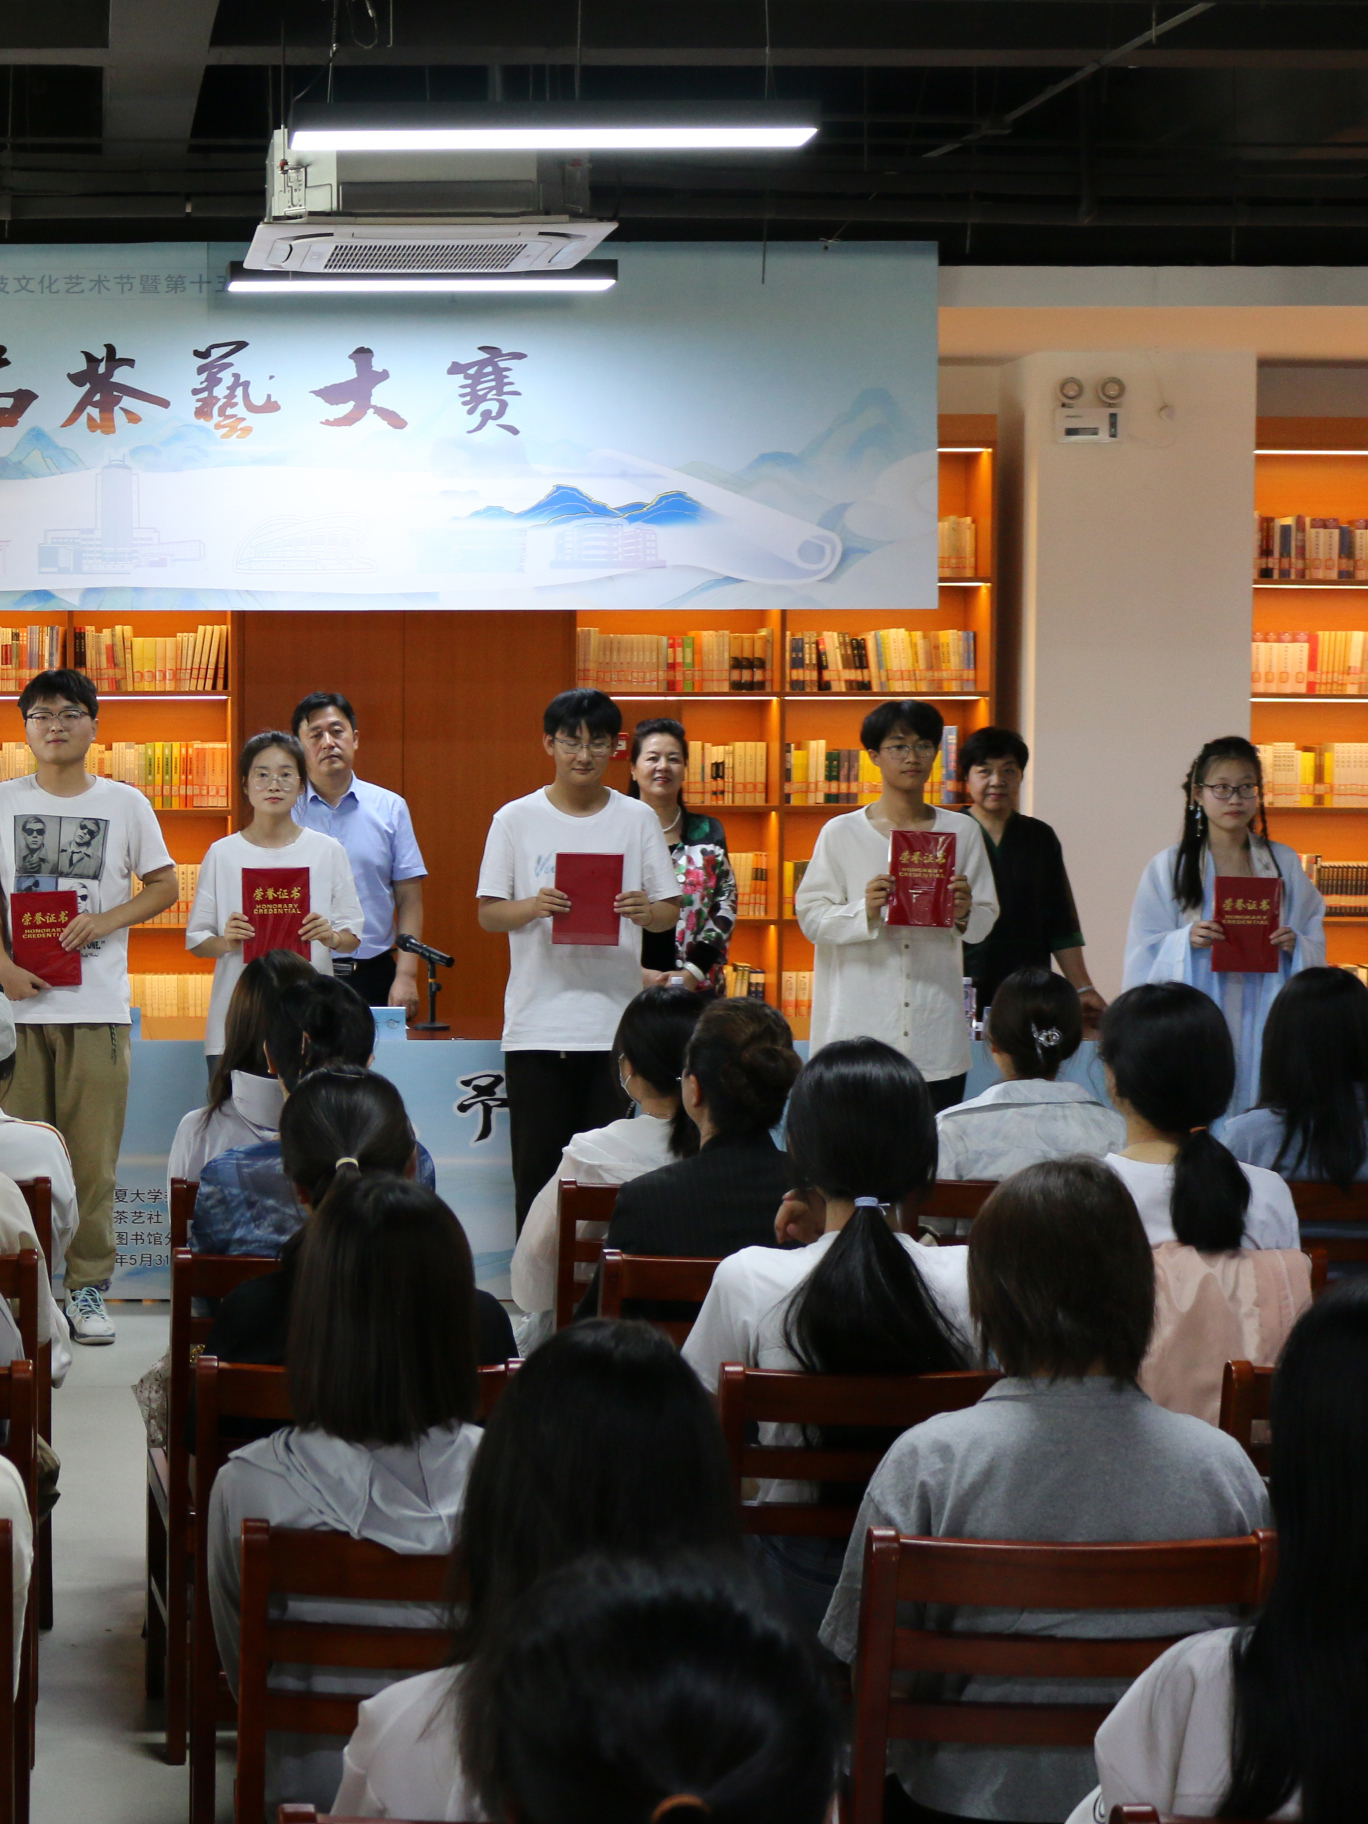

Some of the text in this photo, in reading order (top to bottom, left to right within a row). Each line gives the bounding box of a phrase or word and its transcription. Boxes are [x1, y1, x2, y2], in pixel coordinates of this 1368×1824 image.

[253, 887, 301, 901] 荣誉证书
[1222, 898, 1270, 911] 荣誉证书
[22, 911, 69, 926] 荣誉证书
[114, 1188, 168, 1204] 夏大学
[113, 1210, 163, 1225] 茶艺社
[115, 1252, 169, 1267] 年5月31
